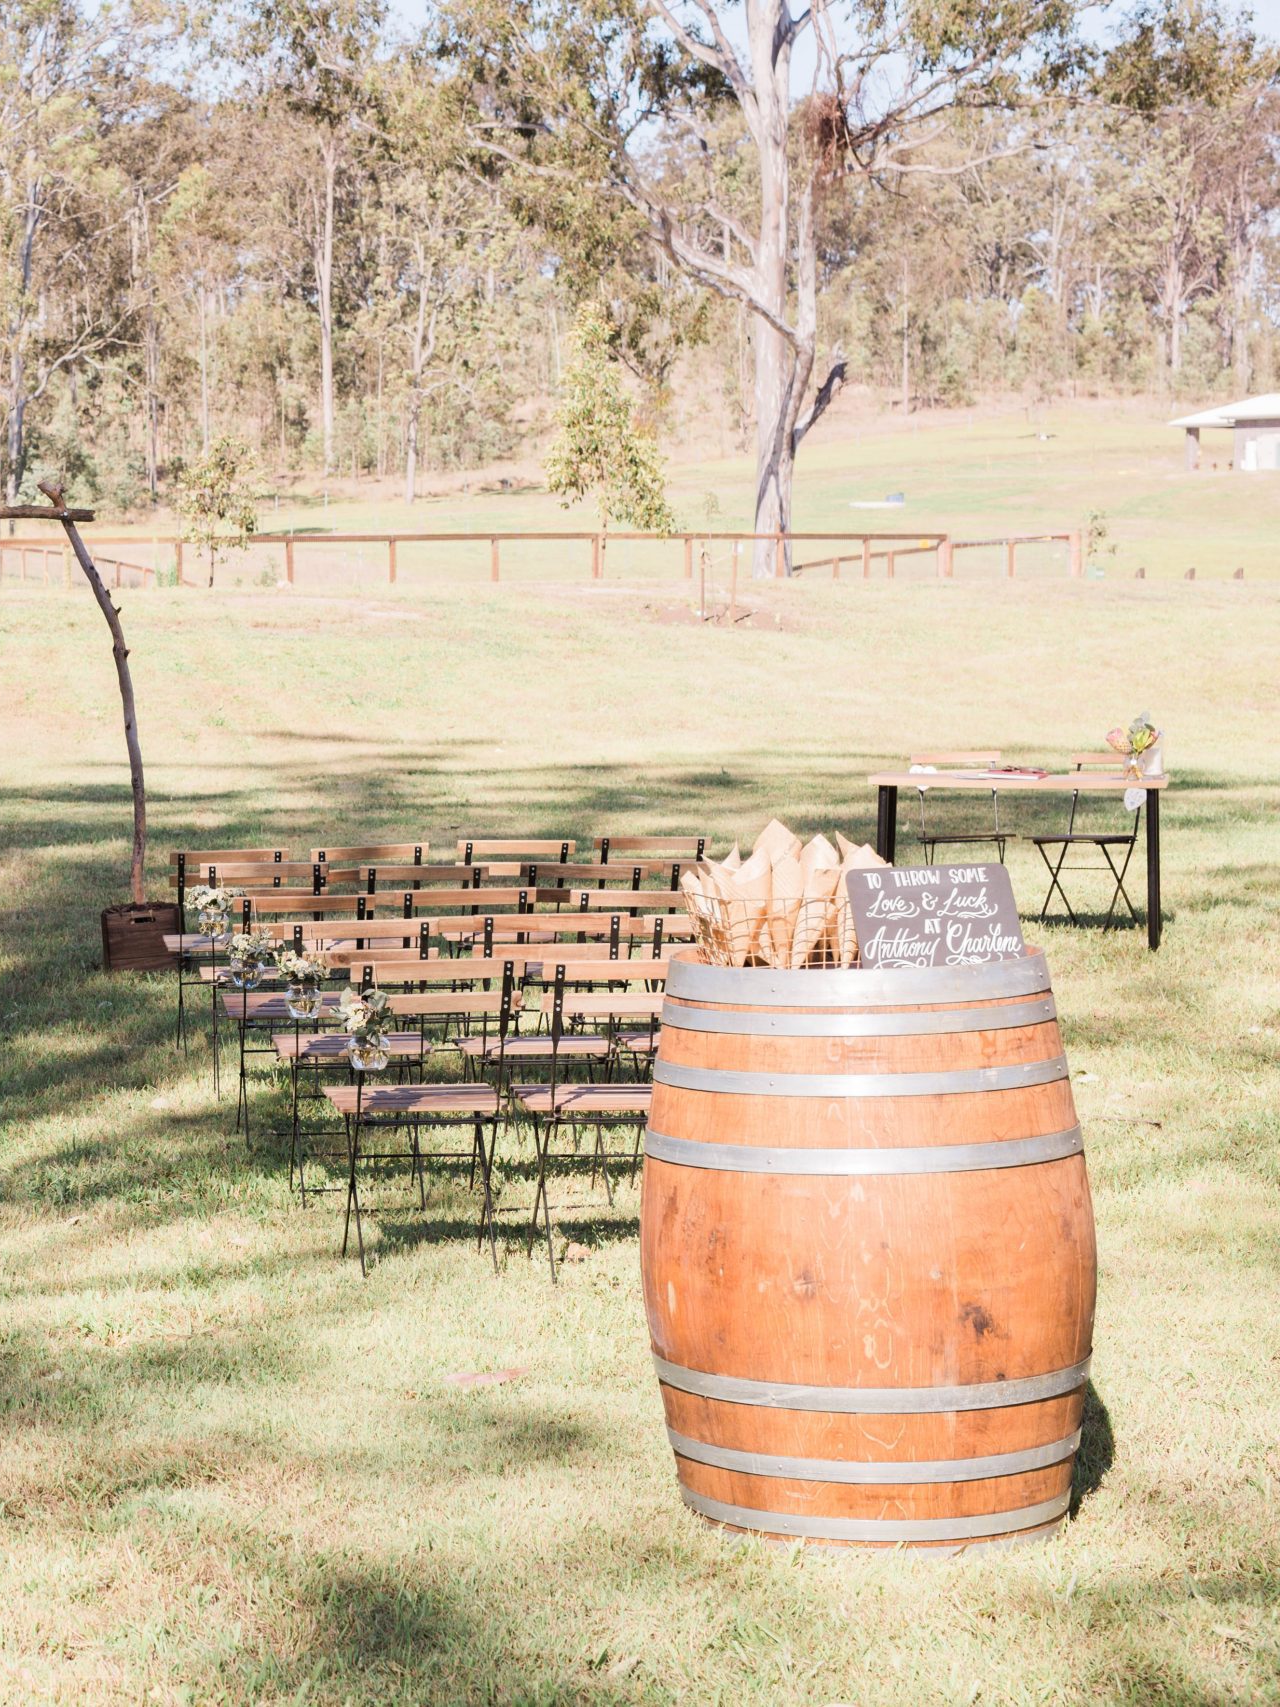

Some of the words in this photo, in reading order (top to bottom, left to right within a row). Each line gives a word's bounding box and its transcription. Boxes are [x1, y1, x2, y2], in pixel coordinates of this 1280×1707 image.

[863, 873, 881, 889] TO
[890, 869, 940, 887] THROW
[949, 867, 989, 884] SOME
[866, 890, 920, 918] Love
[921, 892, 939, 911] &
[936, 887, 998, 918] Luck
[924, 918, 942, 934] AT
[864, 926, 941, 967] Anthony
[946, 920, 1022, 964] Charlene
